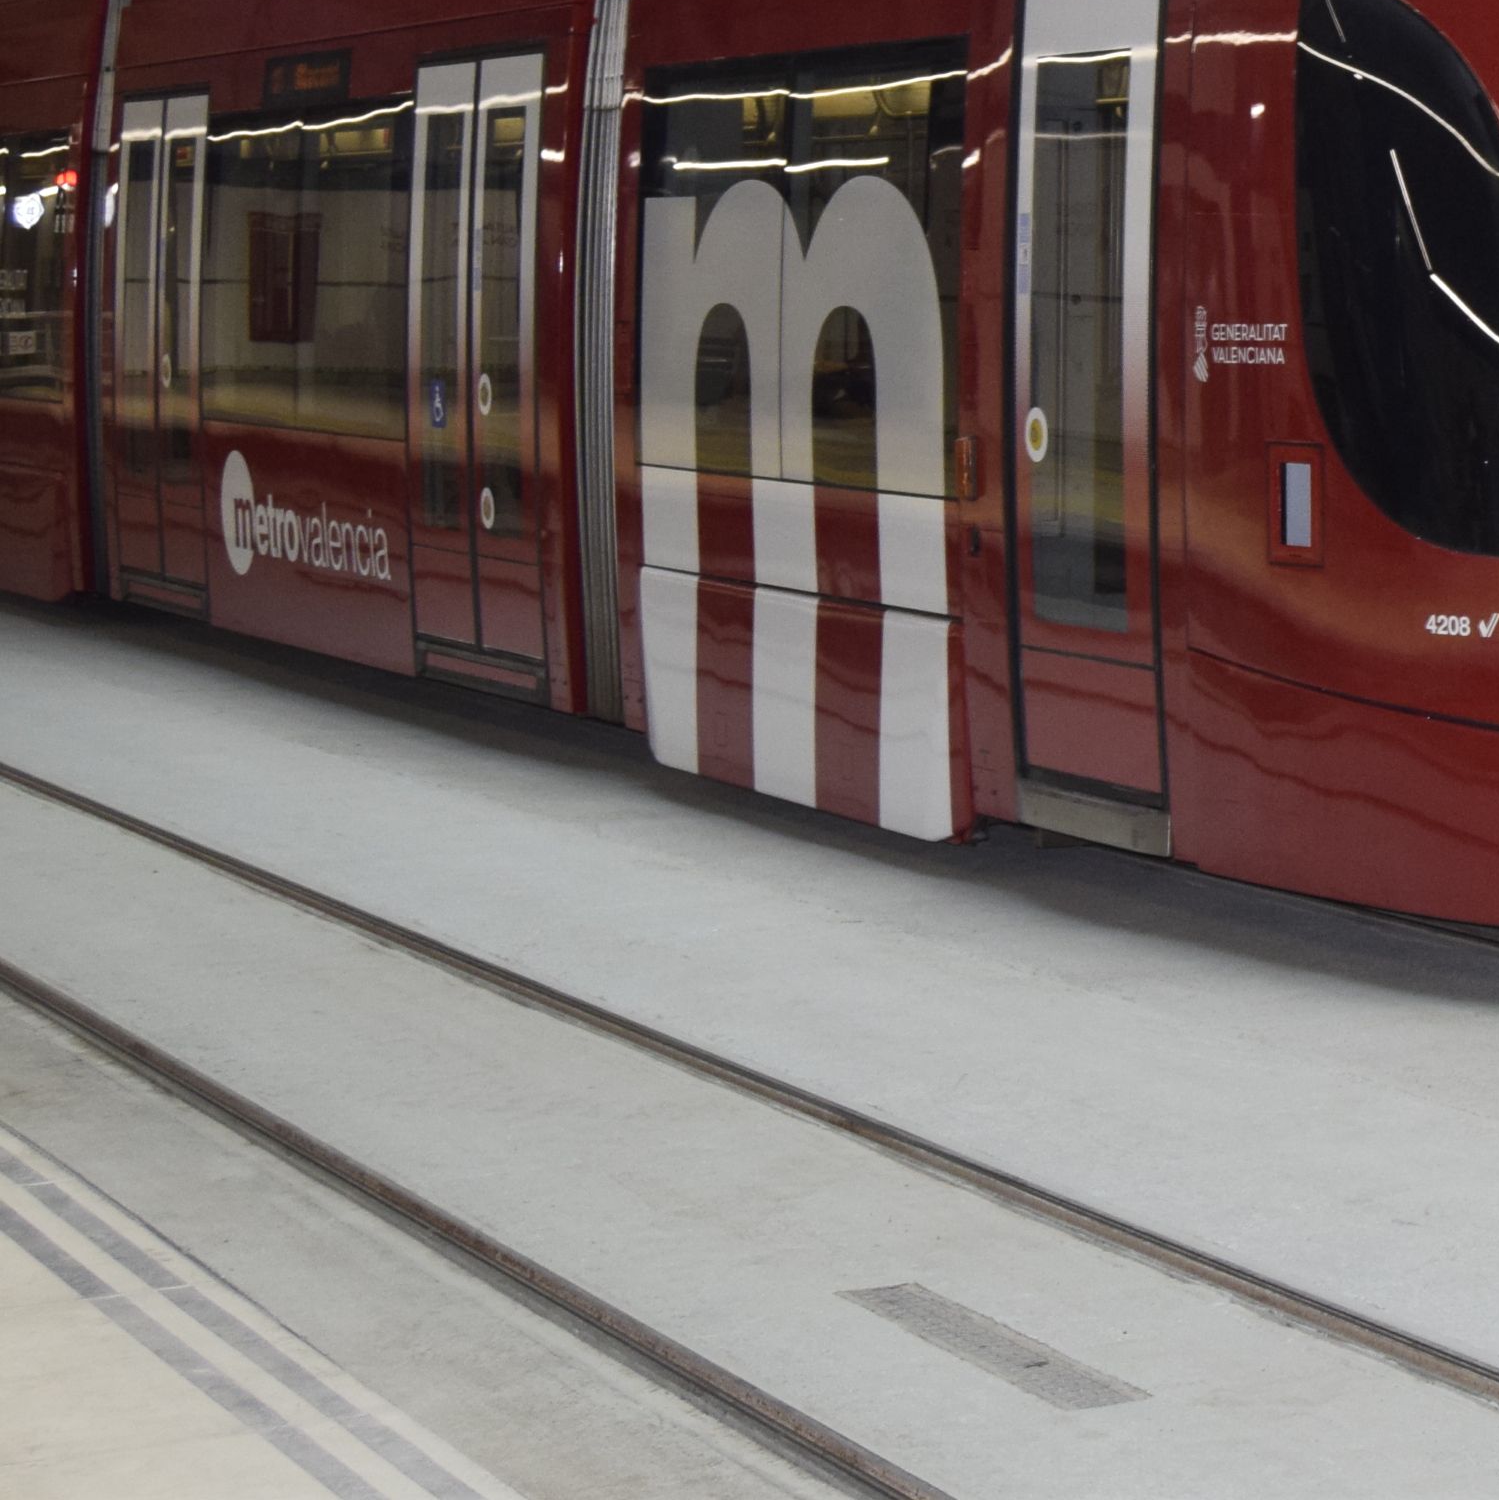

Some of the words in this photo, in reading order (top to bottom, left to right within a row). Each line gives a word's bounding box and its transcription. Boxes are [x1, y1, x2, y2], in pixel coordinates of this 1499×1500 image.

[1211, 323, 1288, 341] GENERALITAT
[1211, 346, 1286, 365] VALENCIANA
[233, 493, 392, 581] metrovalencia
[1425, 614, 1471, 637] 4208
